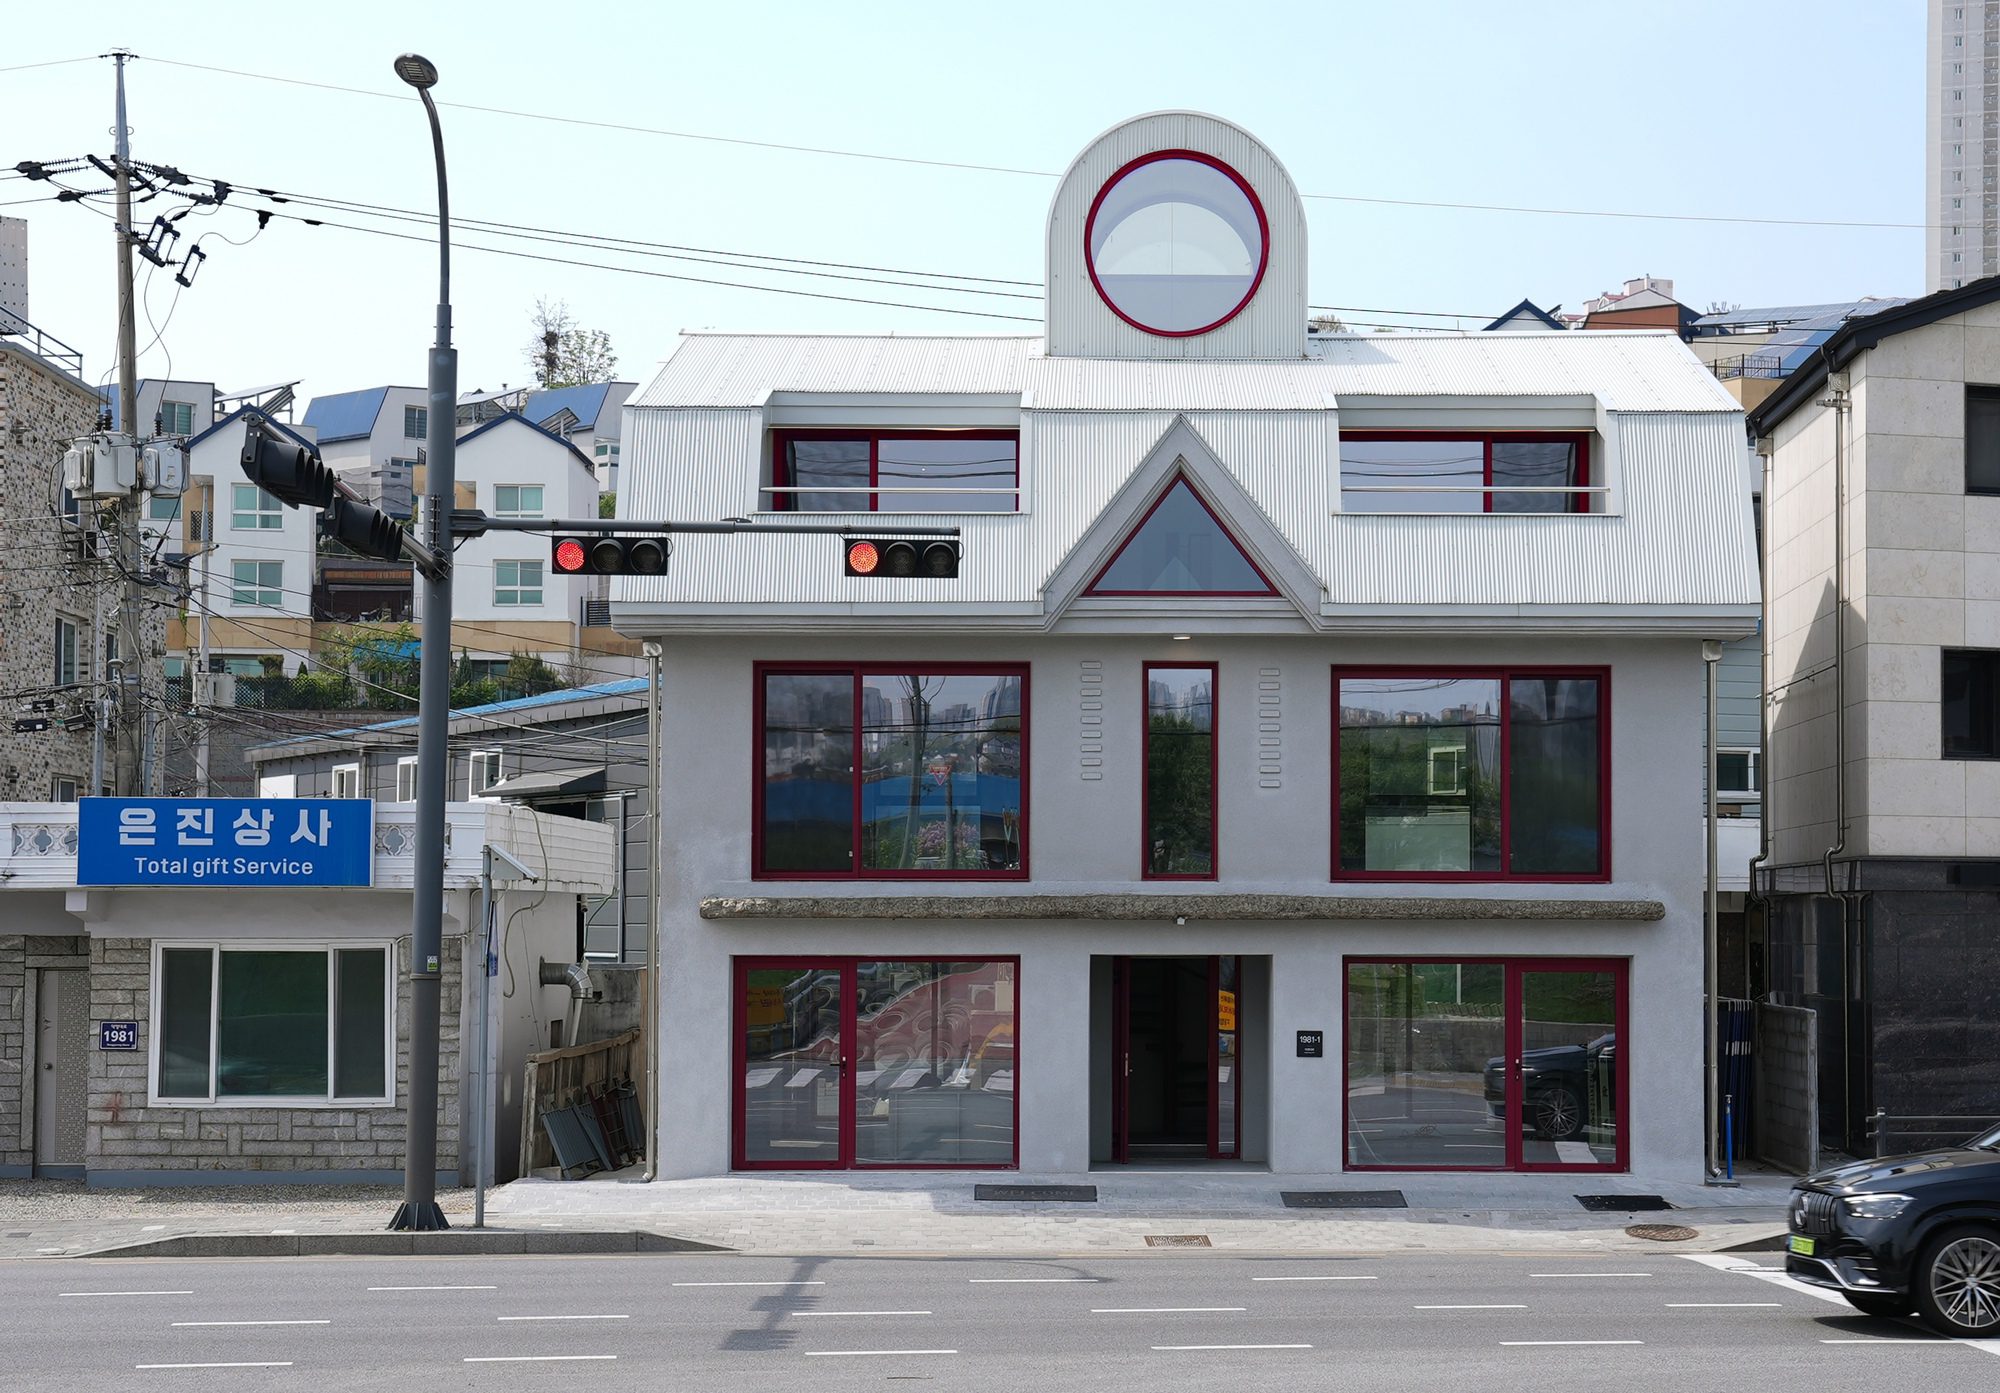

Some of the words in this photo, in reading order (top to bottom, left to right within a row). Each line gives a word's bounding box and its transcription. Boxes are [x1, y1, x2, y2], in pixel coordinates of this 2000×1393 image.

[134, 857, 187, 874] Total
[192, 857, 229, 878] gift
[233, 857, 313, 875] Service
[104, 1030, 133, 1042] 1981
[1300, 1035, 1320, 1044] 1981-1
